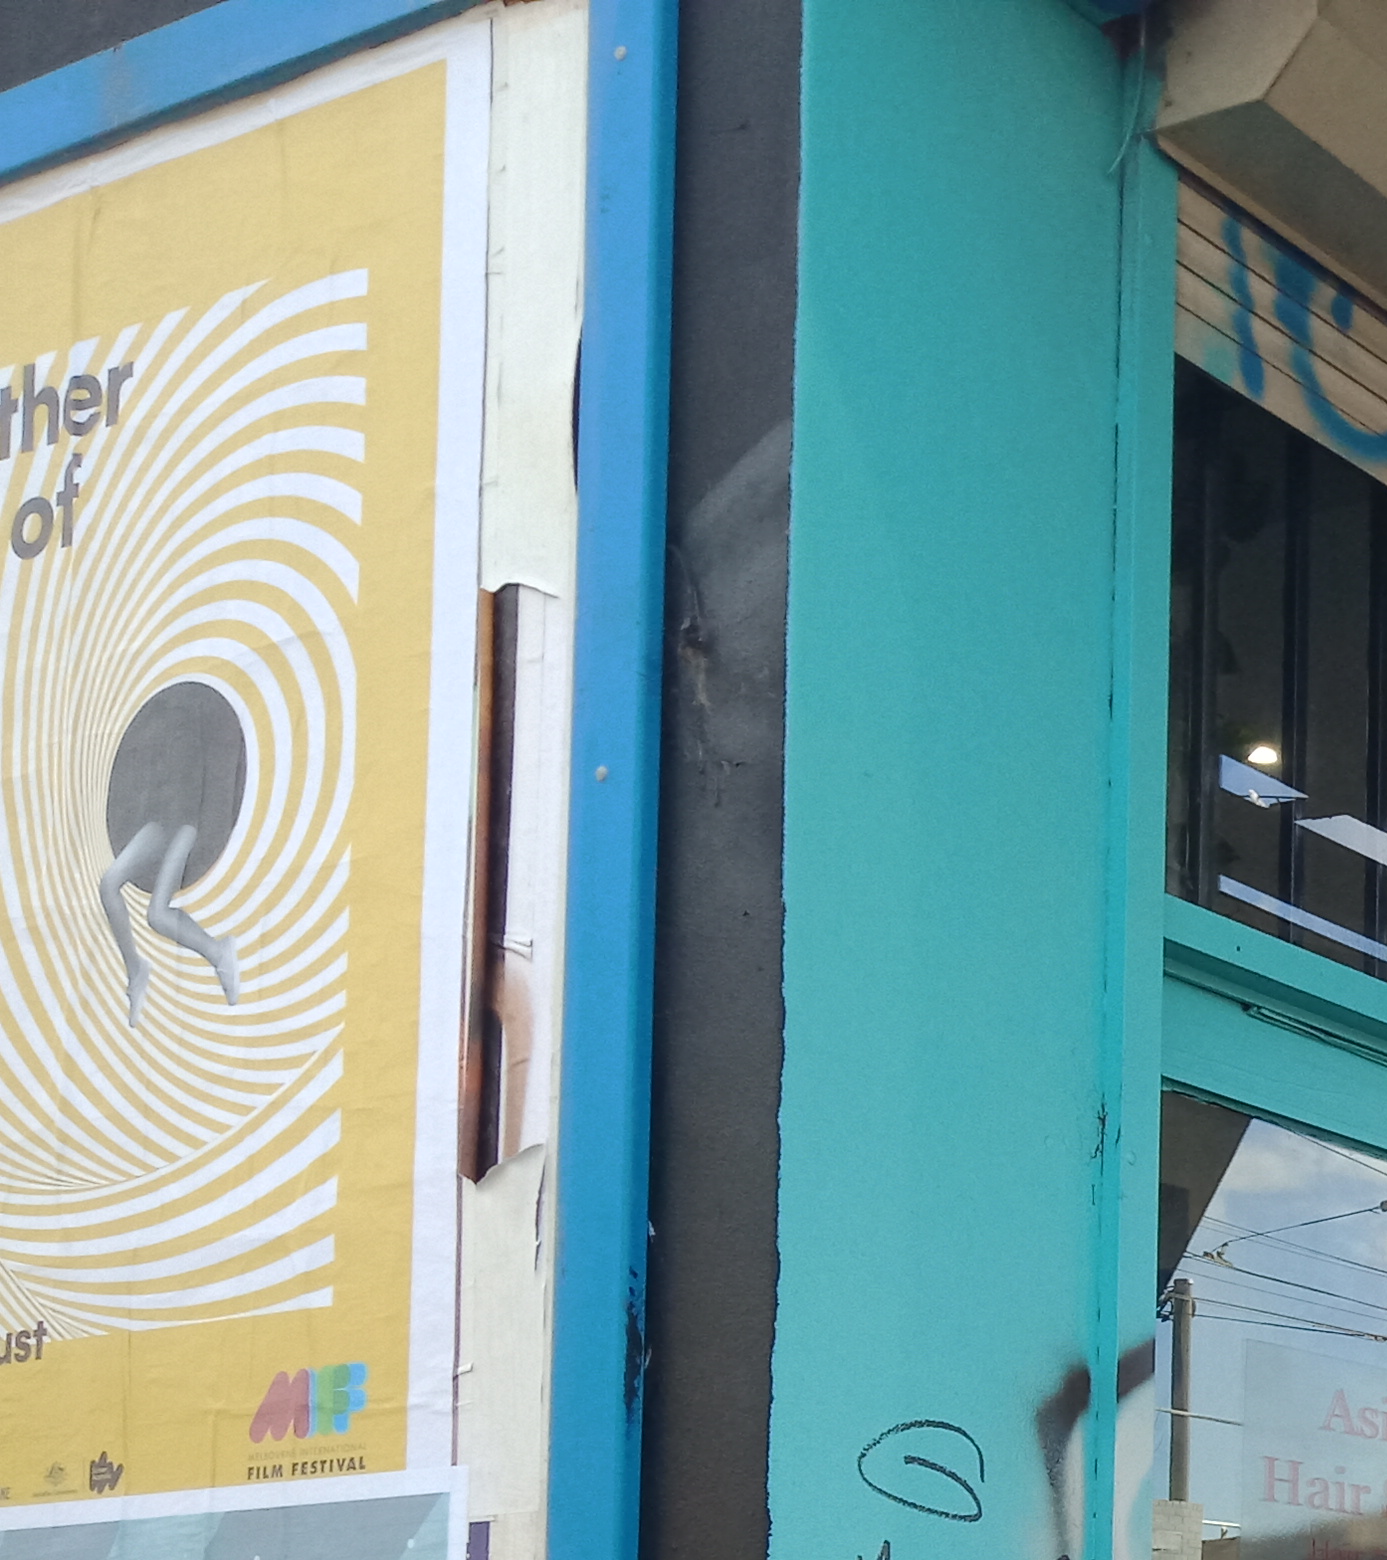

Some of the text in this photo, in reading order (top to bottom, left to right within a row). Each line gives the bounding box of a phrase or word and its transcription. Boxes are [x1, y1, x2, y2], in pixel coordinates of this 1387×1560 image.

[11, 453, 83, 560] of
[247, 1456, 366, 1480] FILM FESTIVAL
[1261, 1456, 1372, 1516] Hair
